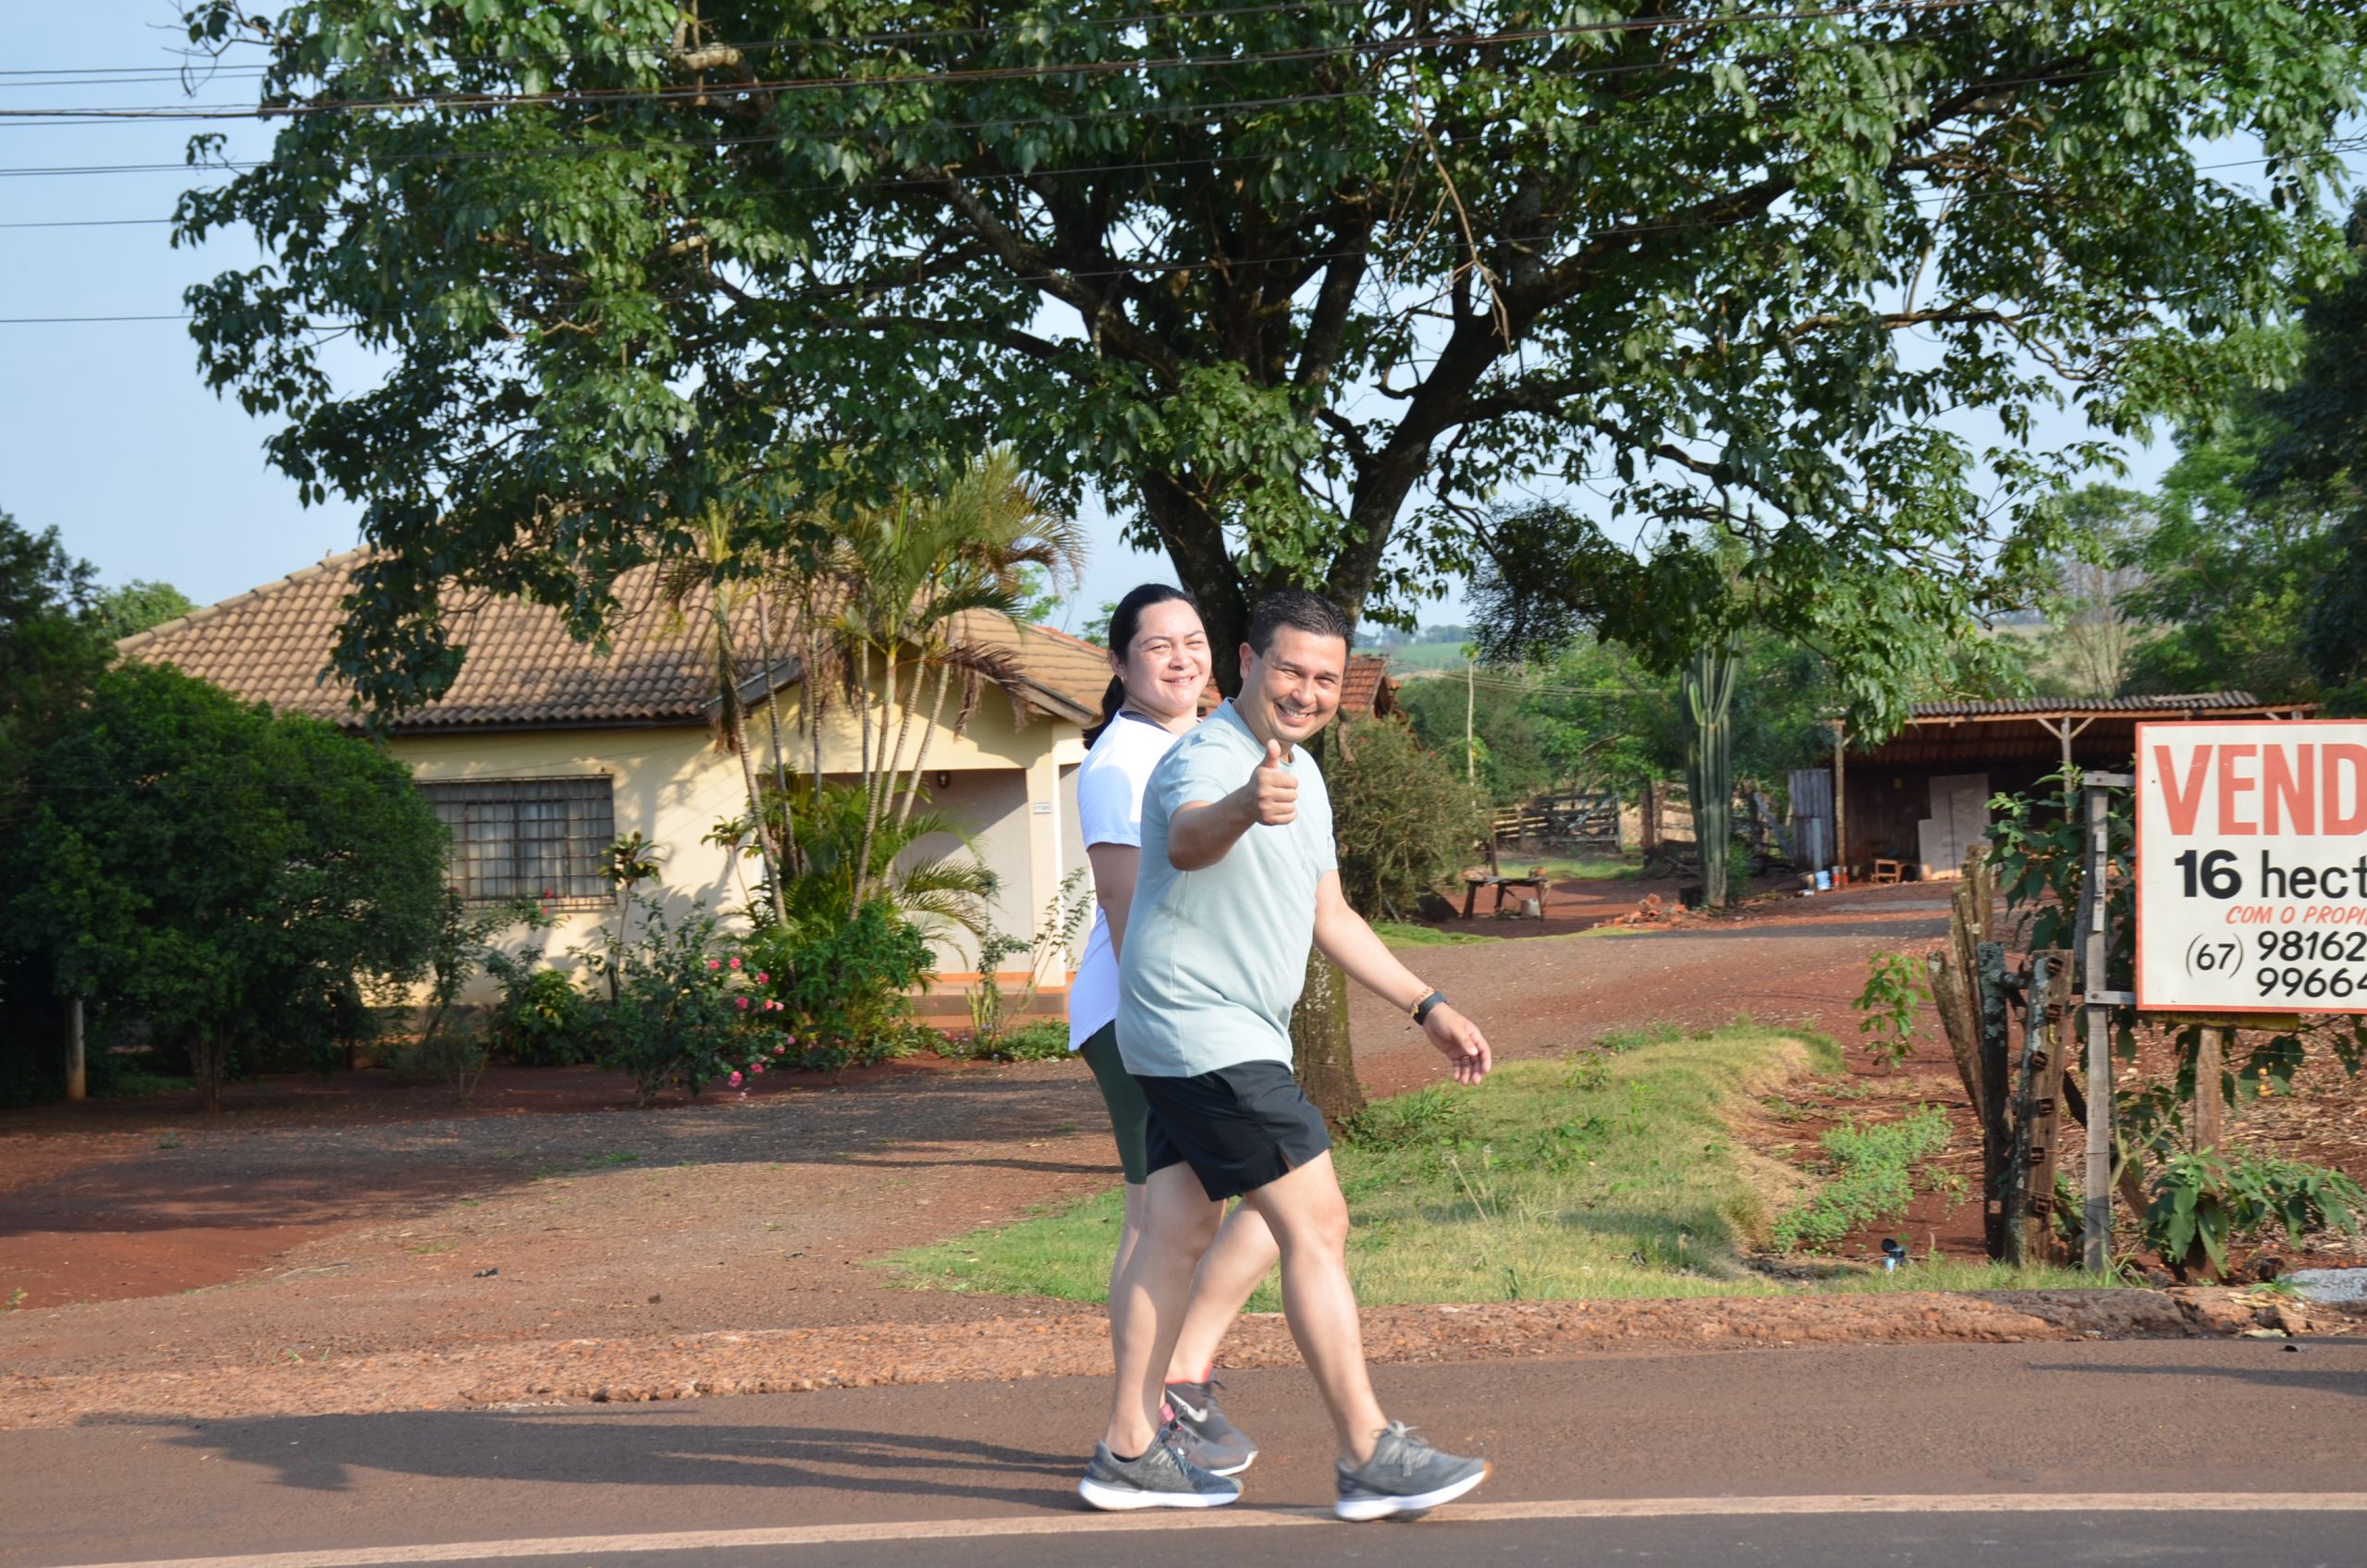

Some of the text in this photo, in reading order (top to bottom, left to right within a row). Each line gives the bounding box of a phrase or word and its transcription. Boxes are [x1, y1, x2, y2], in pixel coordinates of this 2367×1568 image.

[2153, 743, 2367, 836] VEND
[2174, 849, 2367, 900] 16 hect
[2226, 905, 2367, 925] COM O PROPI
[2186, 930, 2367, 979] (67) 98162
